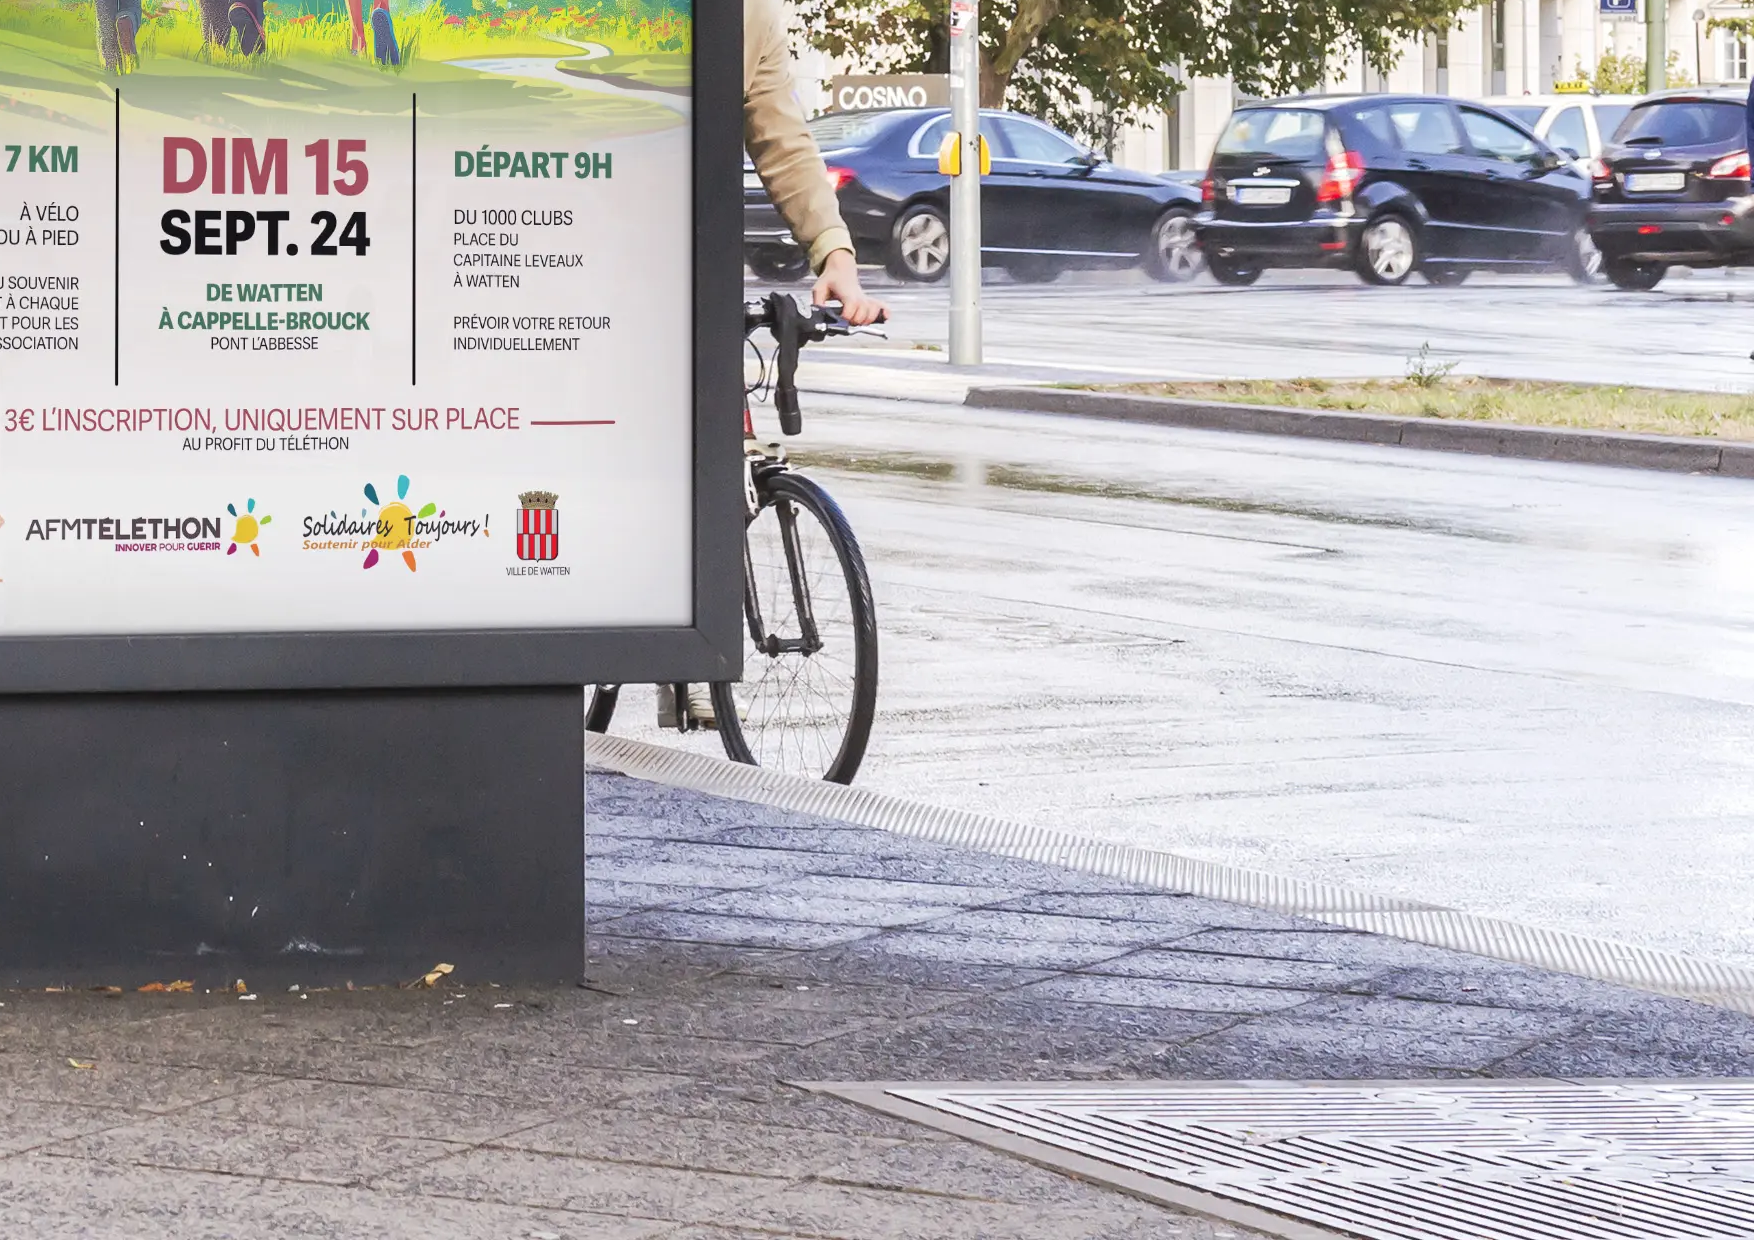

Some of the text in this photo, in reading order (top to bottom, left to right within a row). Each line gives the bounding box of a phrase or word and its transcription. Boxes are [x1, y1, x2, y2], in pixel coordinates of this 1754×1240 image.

[838, 85, 928, 110] COSMO
[5, 145, 78, 172] 7 KM
[163, 137, 368, 196] DIM 15
[455, 144, 612, 179] DÉPART 9H
[20, 202, 79, 221] À VÉLO
[455, 210, 572, 225] DU 1000 CLUBS
[26, 226, 36, 245] À
[43, 230, 78, 245] PIED
[160, 209, 370, 256] SEPT. 24
[454, 233, 518, 246] PLACE DU
[454, 254, 583, 267] CAPITAINE LEVEAUX
[8, 276, 79, 290] SOUVENIR
[454, 272, 519, 287] À WATTEN
[207, 284, 322, 302] DE WATTEN
[6, 294, 15, 309] À
[20, 296, 78, 310] CHAQUE
[12, 316, 50, 329] POUR
[56, 317, 78, 330] LES
[158, 307, 370, 330] À CAPPELLE-BROUCK
[454, 314, 610, 330] PRÉVOIR VOTRE RETOUR
[211, 337, 318, 350] PONT L'ABBESSE
[454, 337, 580, 350] INDIVIDUELLEMENT
[5, 407, 519, 434] 3€ L'INSCRIPTION, UNIQUEMENT SUR PLACE
[183, 435, 349, 451] AU PROFIT DU TÉLÉTHON
[302, 510, 393, 537] Solidaires
[115, 543, 157, 551] INNOVER
[159, 543, 185, 551] POUR
[303, 538, 432, 551] Soutenir pour Aider
[506, 567, 570, 575] VILLE DE WATTEN
